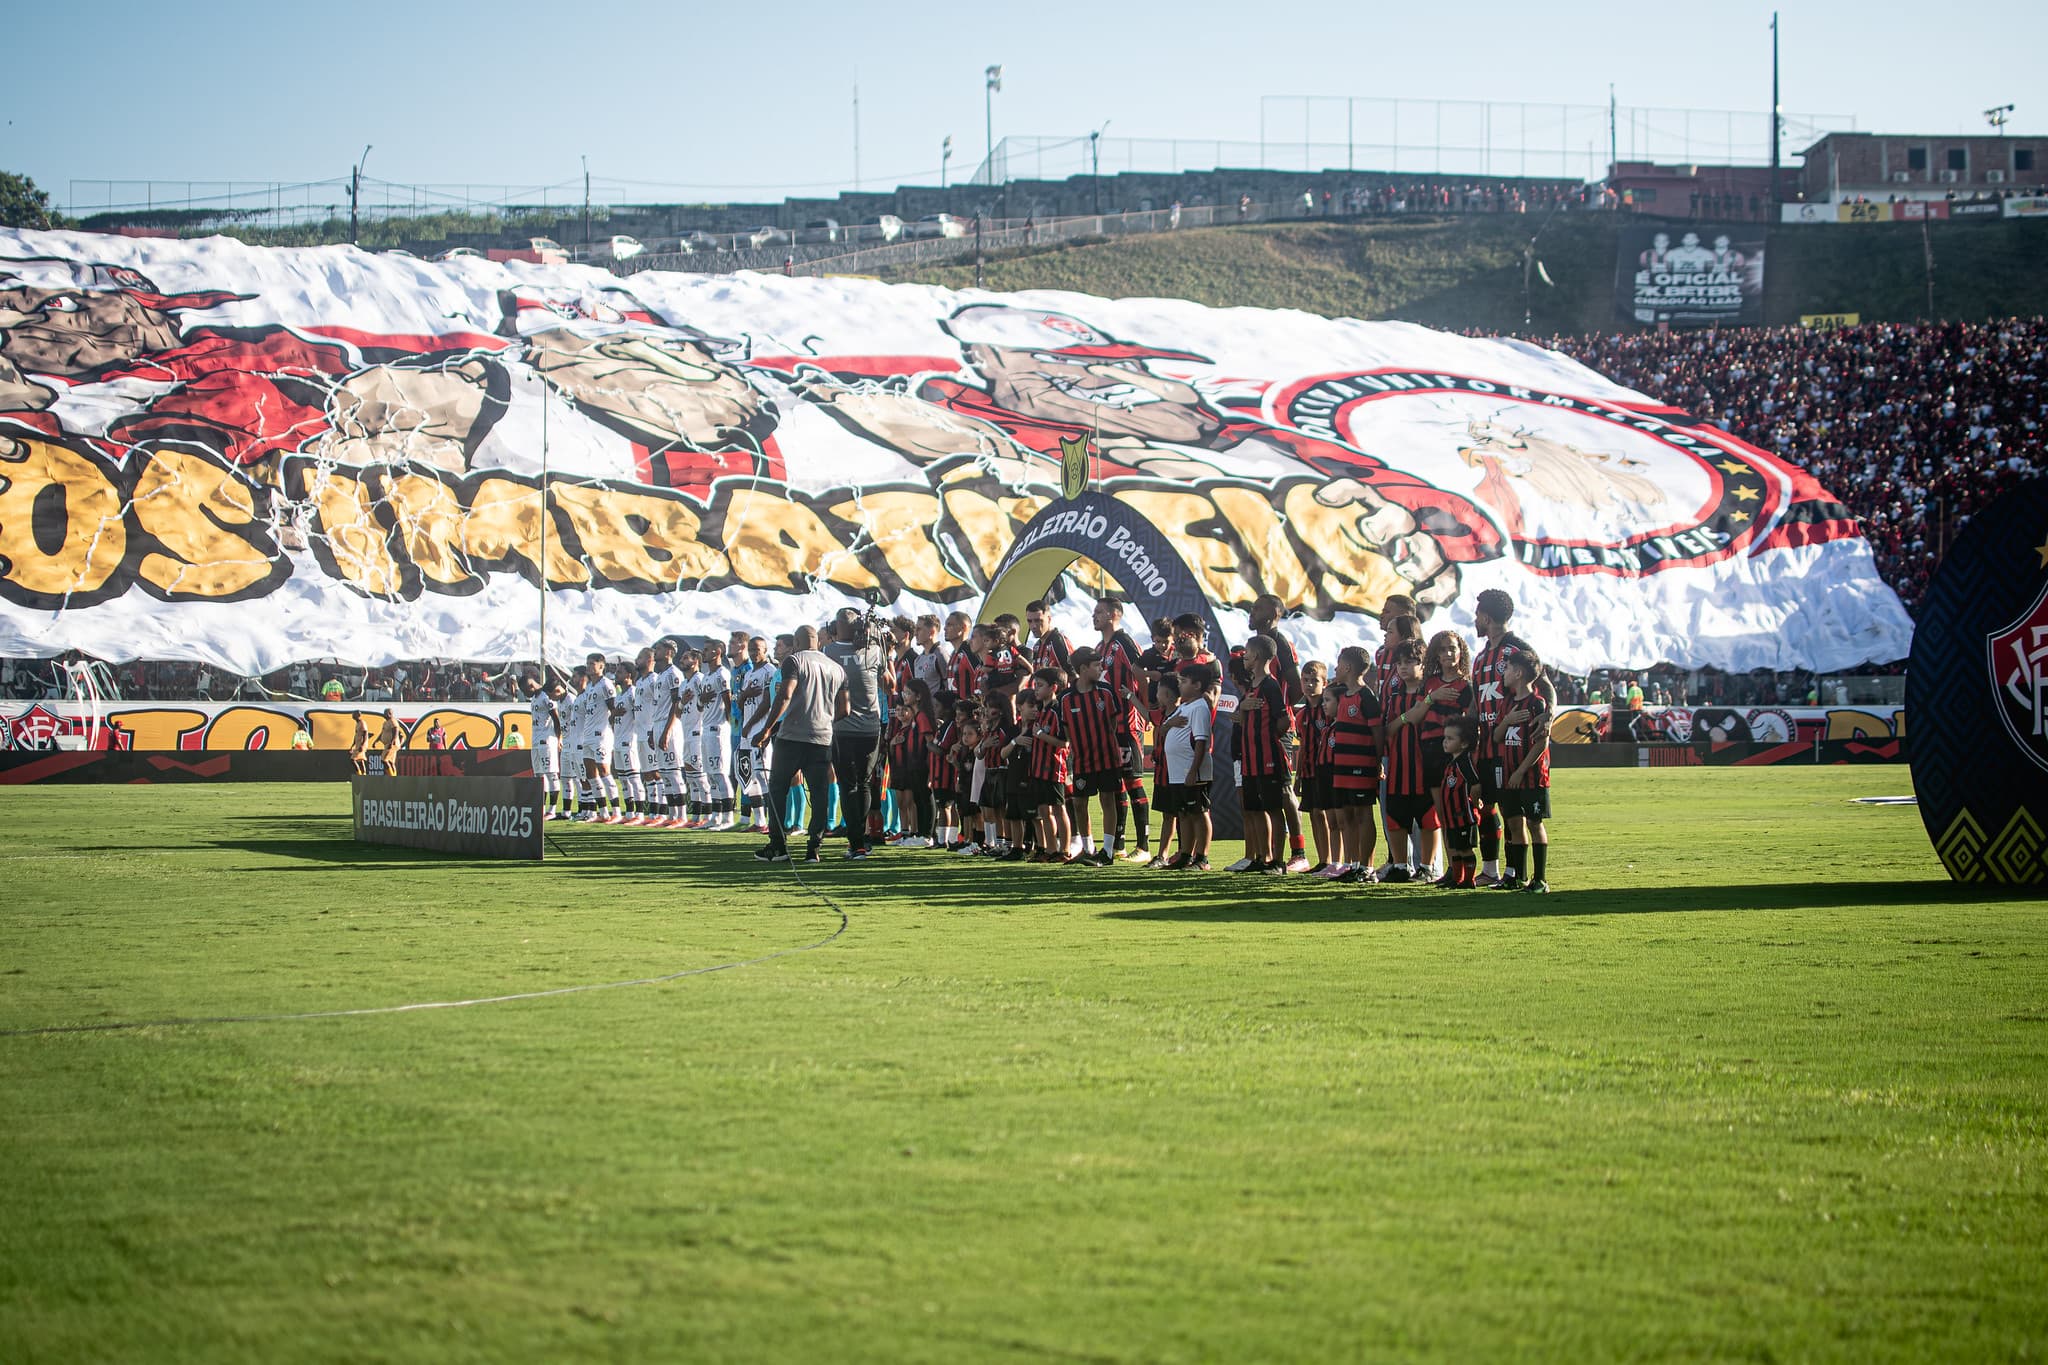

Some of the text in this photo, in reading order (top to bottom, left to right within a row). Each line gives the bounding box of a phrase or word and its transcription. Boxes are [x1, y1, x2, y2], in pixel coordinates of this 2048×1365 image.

[1635, 269, 1744, 285] É OFICIAL
[1814, 317, 1845, 329] BAR
[1106, 525, 1168, 597] Betano
[840, 655, 865, 665] TV
[1479, 681, 1504, 703] 7K
[1217, 699, 1234, 708] ano
[664, 752, 676, 762] 20
[709, 756, 721, 767] 57
[363, 793, 533, 839] BRASILEIRÃO Betano 2025
